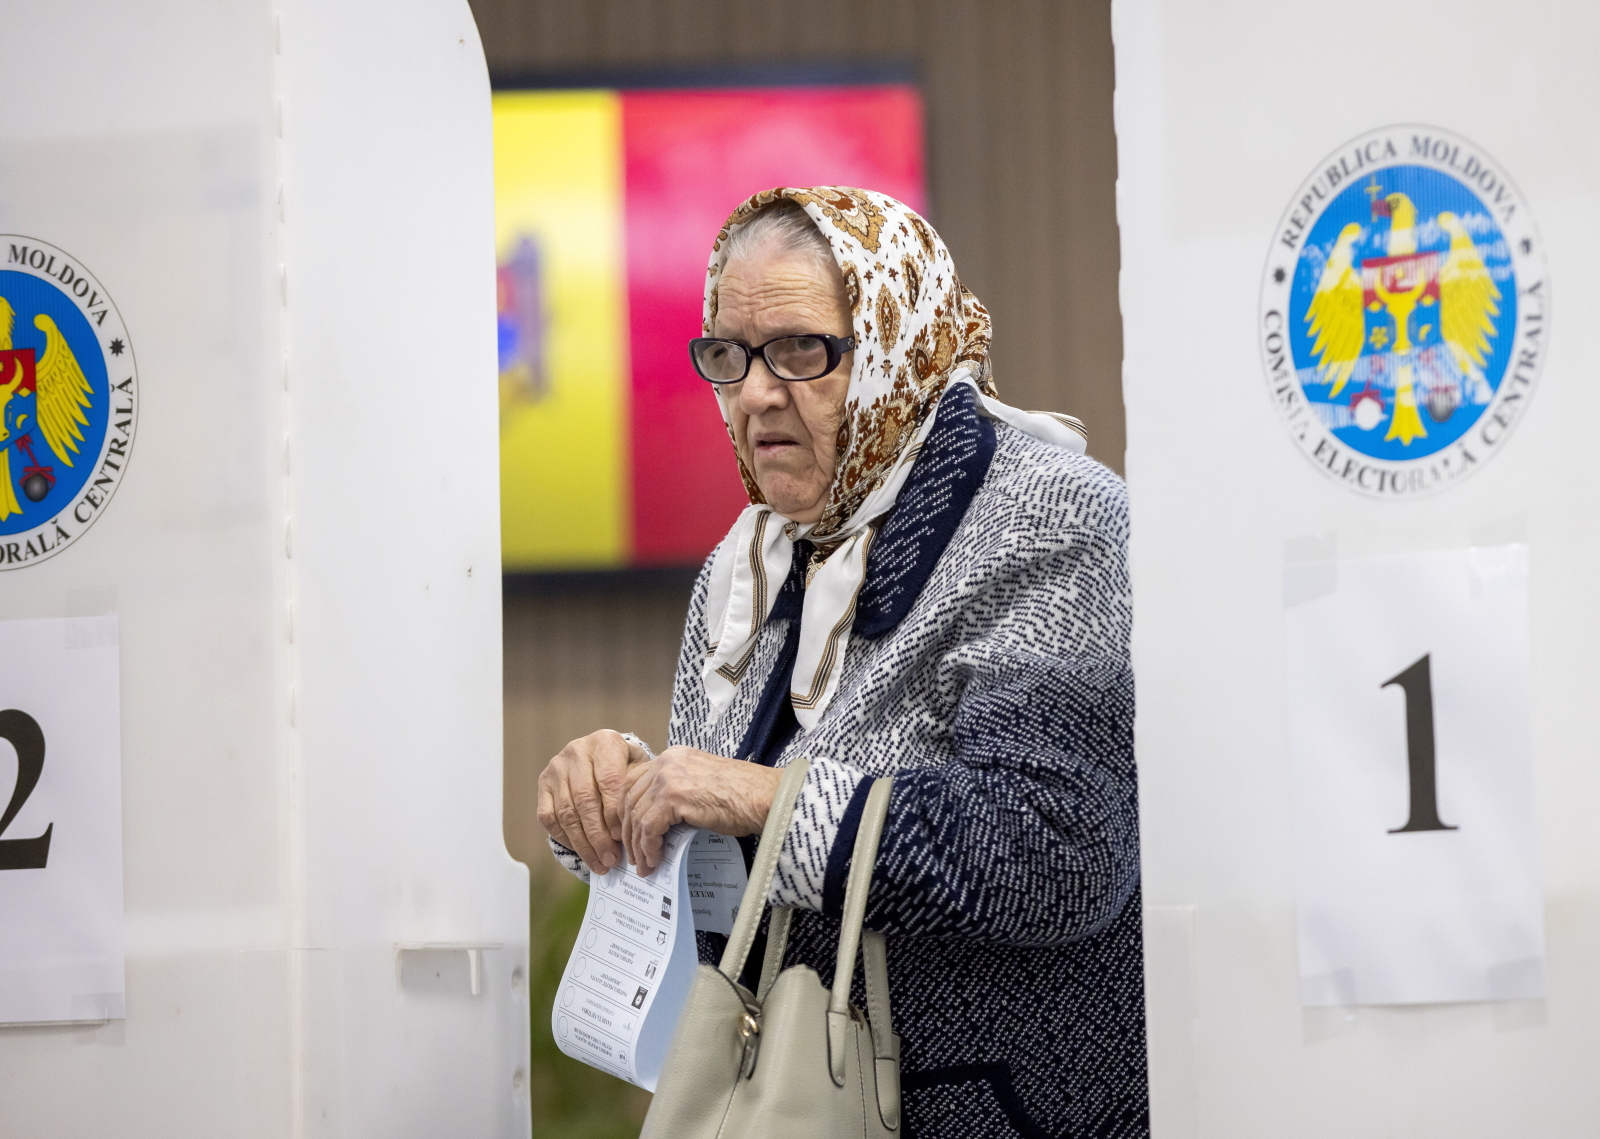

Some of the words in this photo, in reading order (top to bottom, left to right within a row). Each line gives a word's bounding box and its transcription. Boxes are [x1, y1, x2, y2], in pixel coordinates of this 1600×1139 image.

[1281, 138, 1398, 250] REPUBLICA
[1411, 135, 1518, 225] MOLDOVA
[8, 244, 109, 327] MOLDOVA
[0, 518, 71, 564] RALĂ
[74, 376, 133, 524] CENTRALĂ
[0, 709, 53, 870] 2
[1380, 651, 1459, 835] 1
